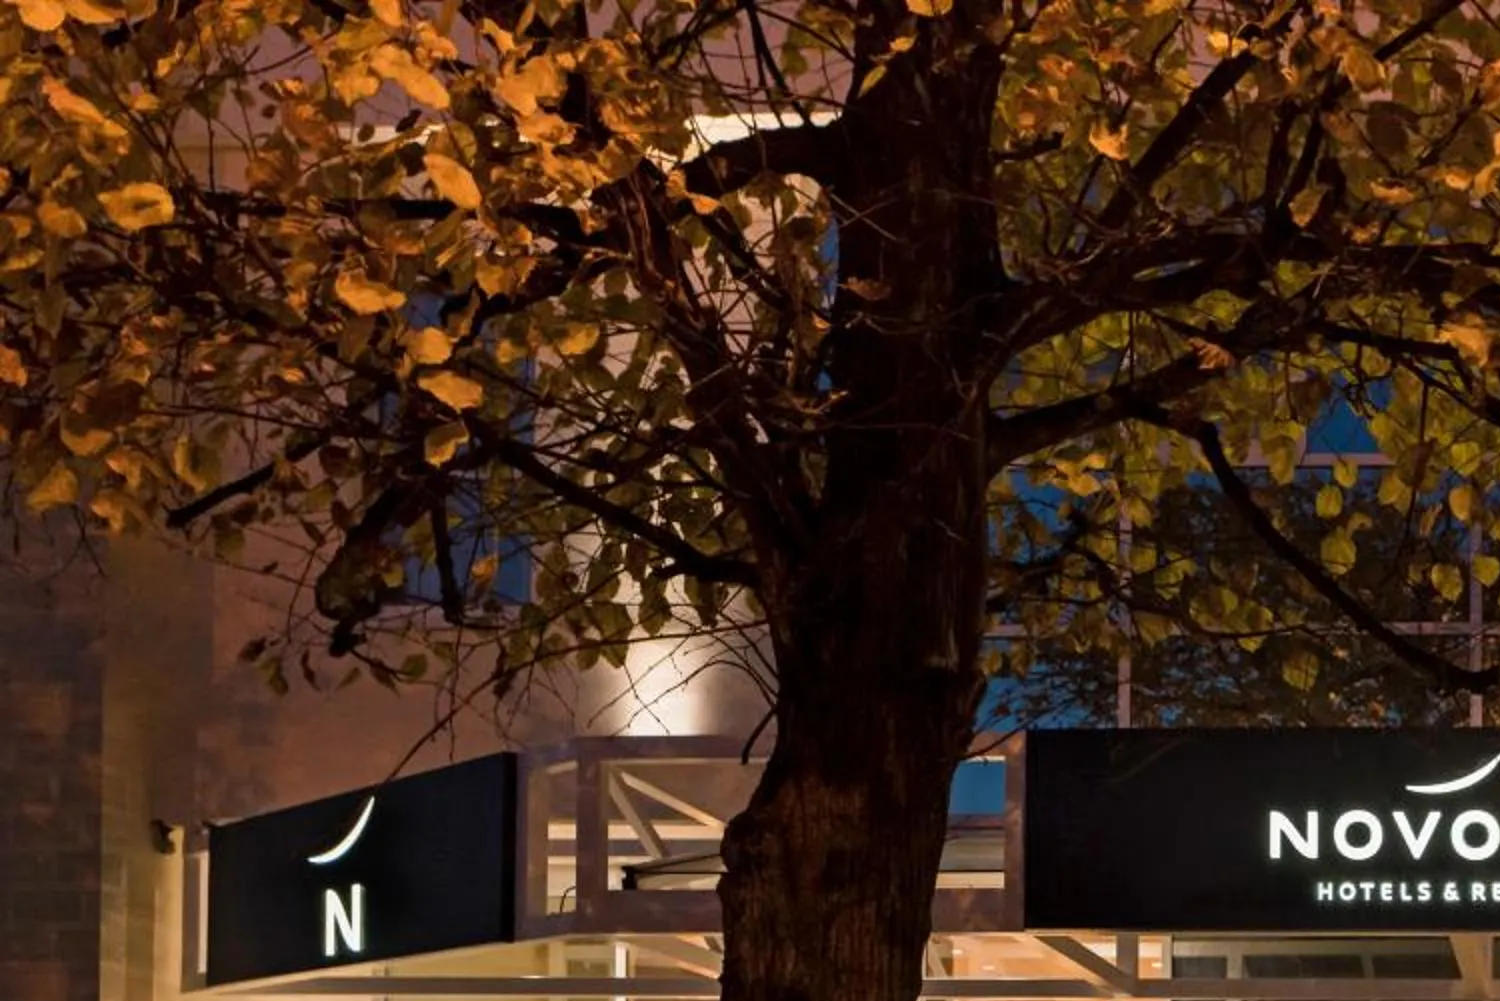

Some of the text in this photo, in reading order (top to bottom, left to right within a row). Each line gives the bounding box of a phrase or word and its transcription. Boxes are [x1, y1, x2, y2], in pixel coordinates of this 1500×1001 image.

[1316, 880, 1432, 903] HOTELS
[1442, 881, 1461, 903] &
[324, 883, 364, 957] N
